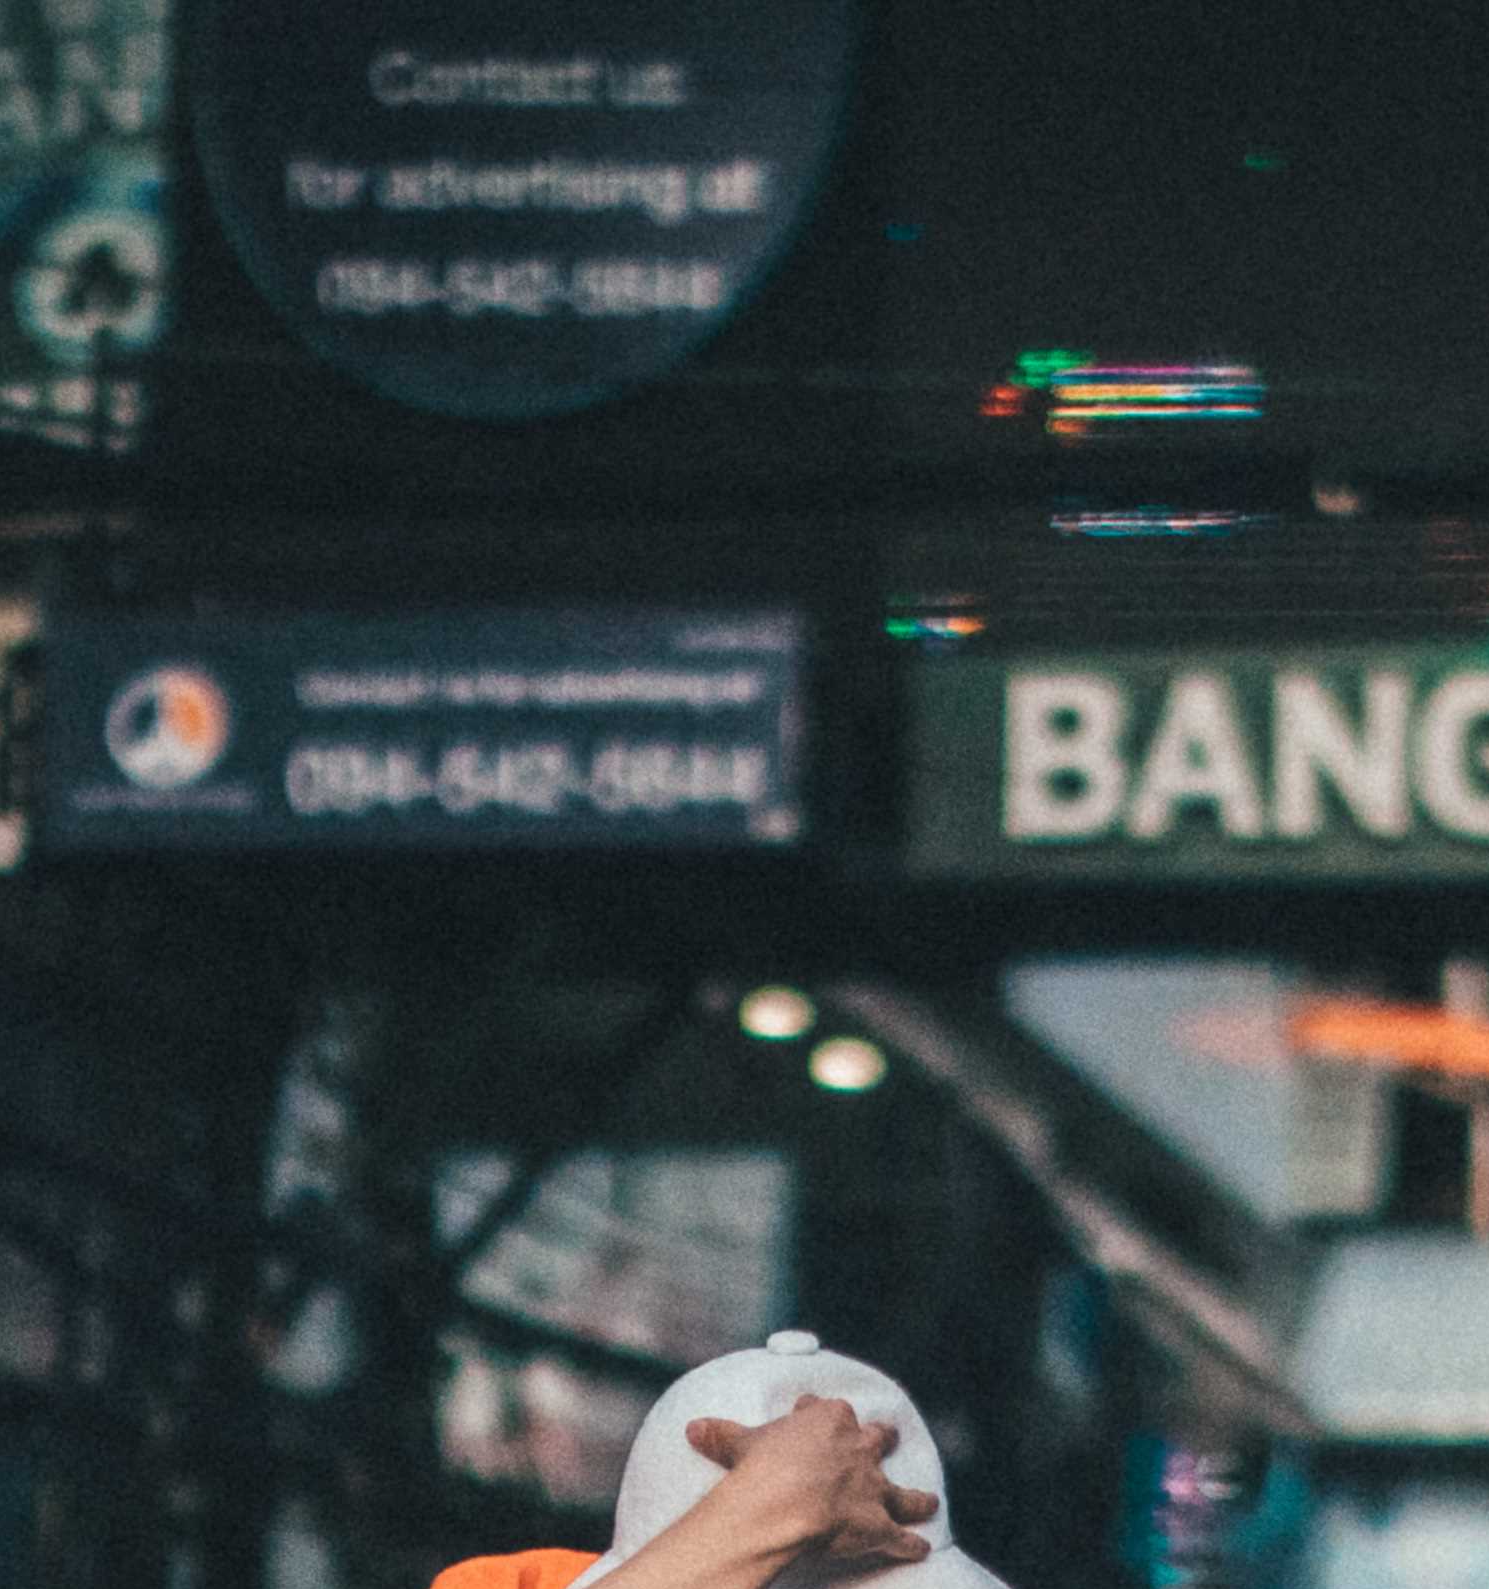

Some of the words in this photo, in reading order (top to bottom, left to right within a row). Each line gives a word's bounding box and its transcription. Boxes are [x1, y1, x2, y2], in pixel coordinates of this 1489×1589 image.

[368, 48, 600, 105] Contact
[287, 157, 366, 211] for
[378, 155, 688, 228] advertising
